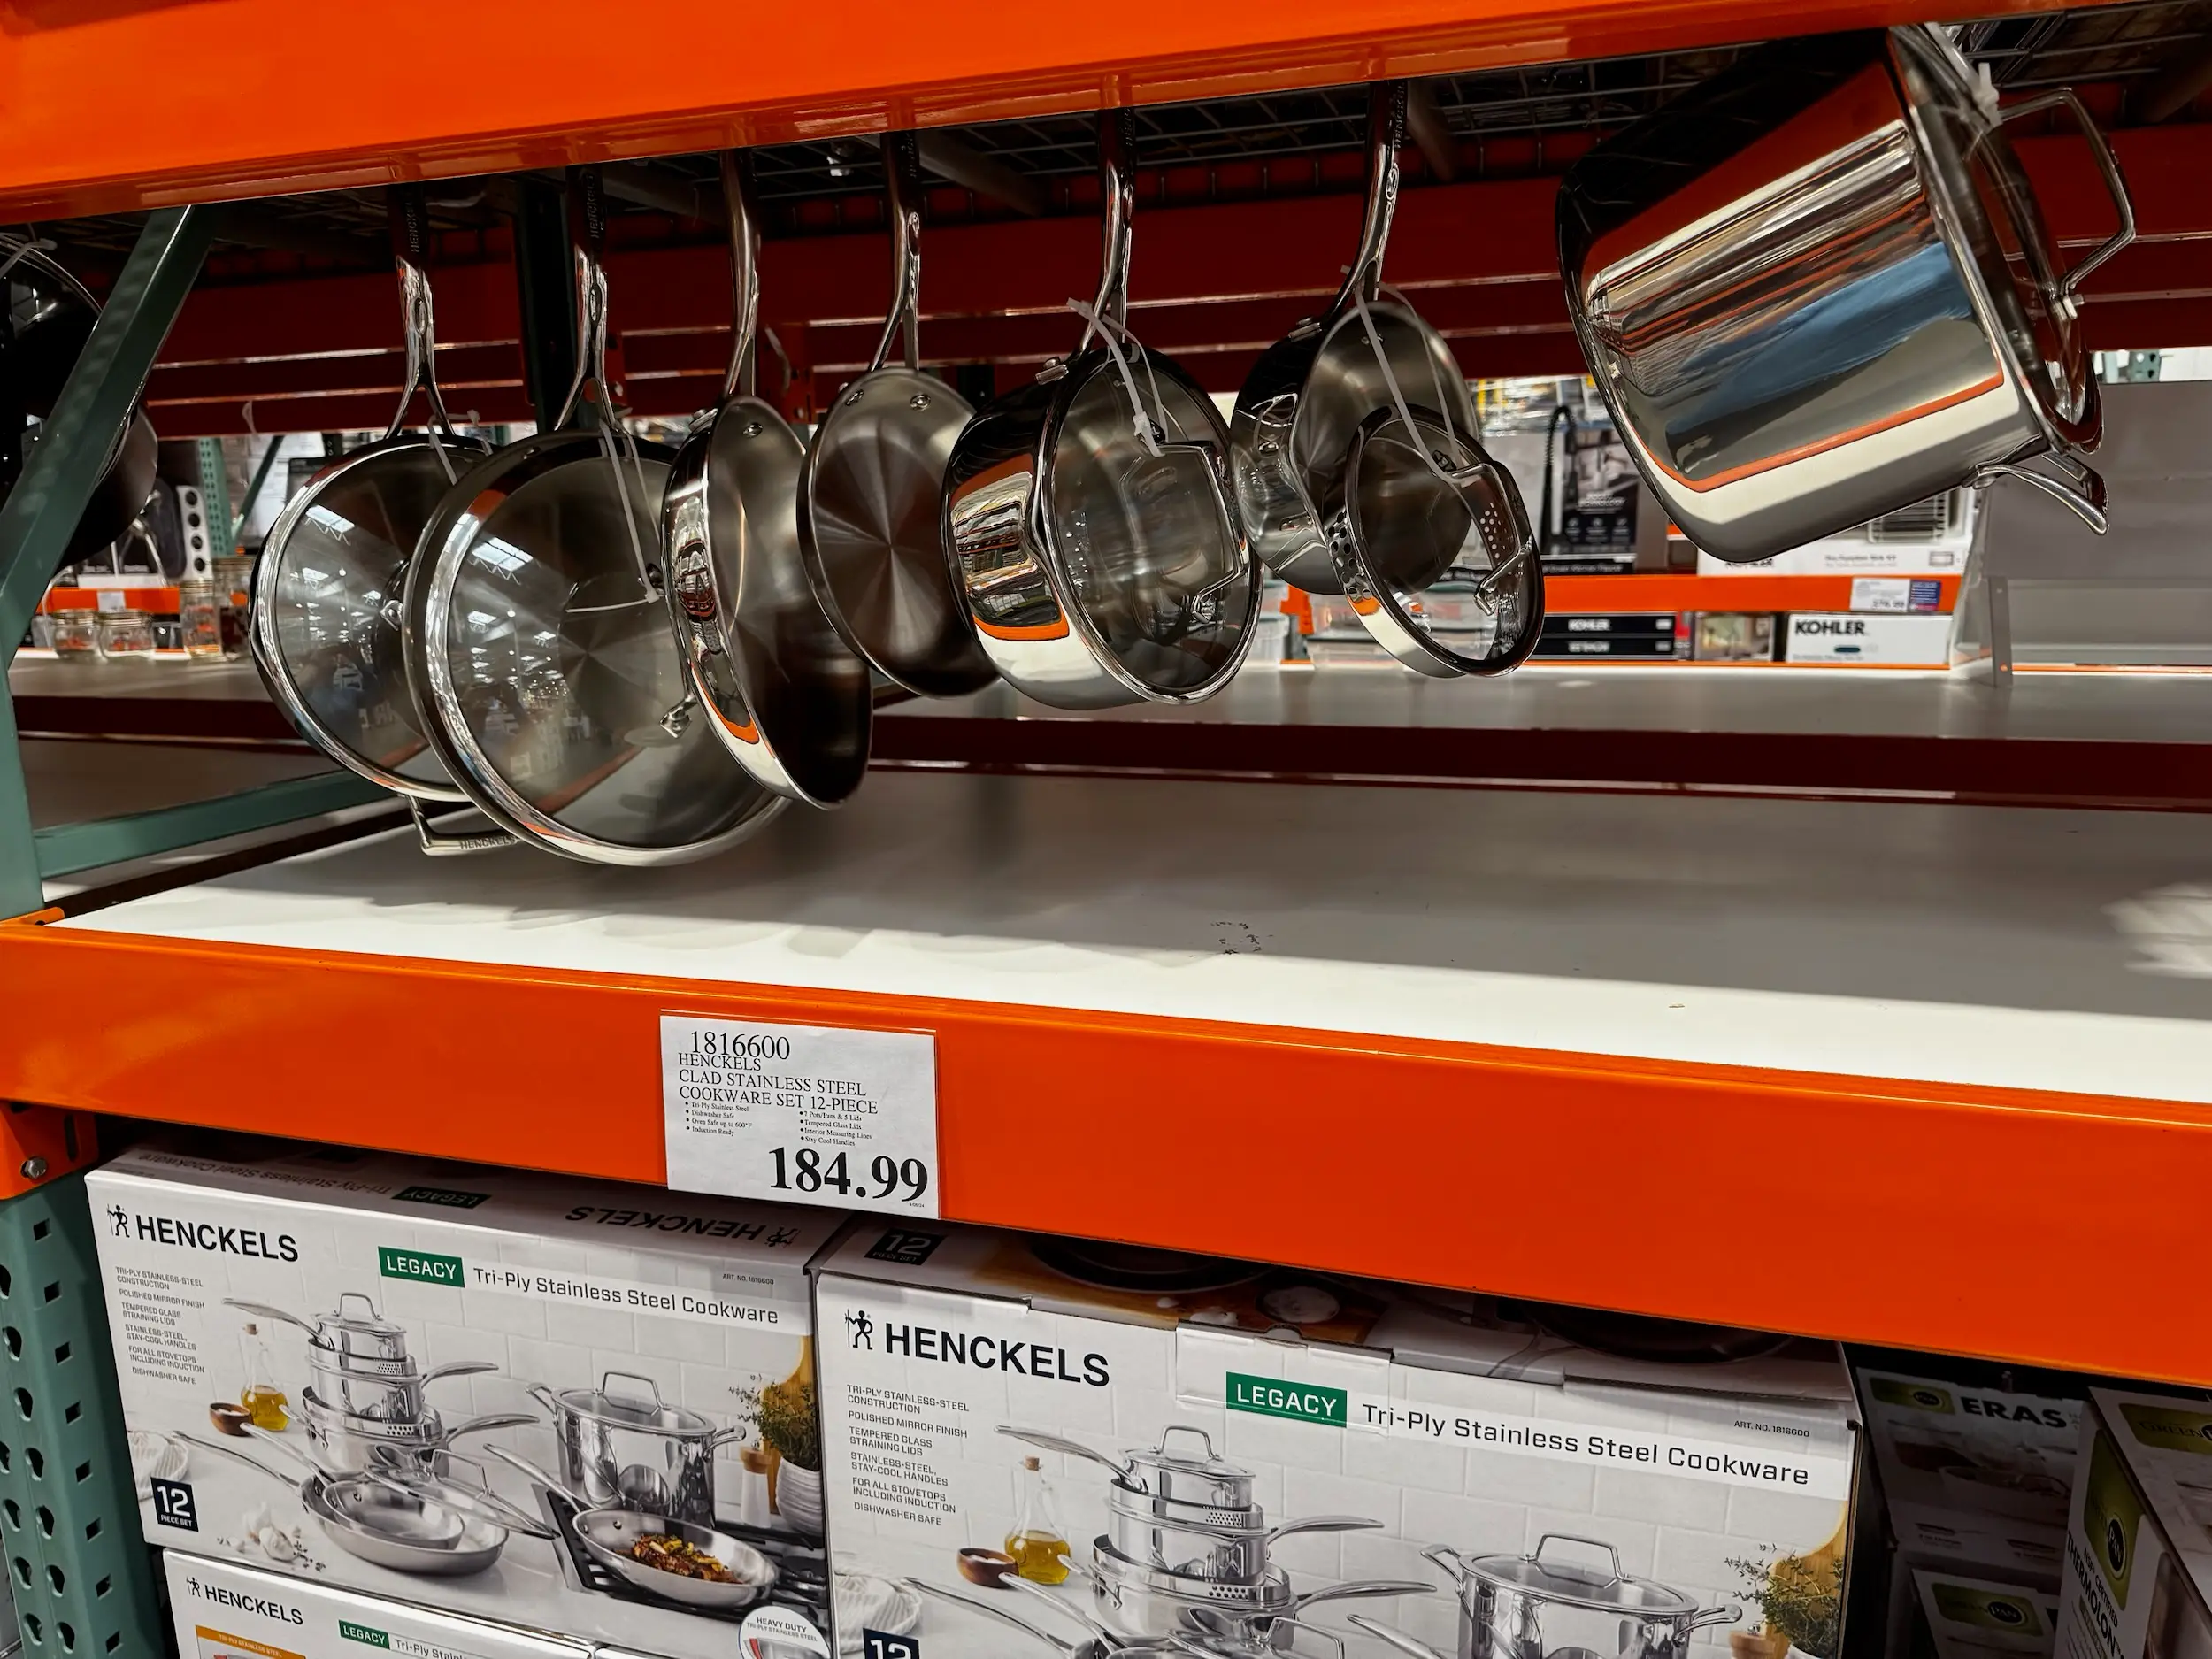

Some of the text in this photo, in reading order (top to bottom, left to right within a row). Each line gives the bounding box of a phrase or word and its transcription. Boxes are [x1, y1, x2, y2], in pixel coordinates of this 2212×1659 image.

[1795, 621, 1864, 635] KOHLER
[691, 1031, 790, 1059] 1816600
[678, 1052, 761, 1071] HENCKELS
[679, 1069, 866, 1096] CLAD STAINLESS STEEL
[680, 1085, 879, 1114] COOKWARE SET 12-PIECE
[718, 1128, 735, 1137] Ready
[804, 1118, 832, 1128] Tempered
[833, 1138, 856, 1147] Handles
[769, 1147, 928, 1202] 184.99
[565, 1207, 767, 1240] HENCKELS
[135, 1214, 299, 1262] HENCKELS
[885, 1233, 932, 1256] 12
[116, 1266, 204, 1287] TRI-PLY STAINLESS-STEEL
[387, 1256, 457, 1279] LEGACY
[117, 1276, 170, 1290] CONSTRUCTION
[119, 1288, 205, 1309] POLISHED MIRROR FINISH
[473, 1268, 779, 1324] Tri-Ply Stainless Steel Cookware
[121, 1302, 181, 1318] TEMPERED GLASS
[123, 1310, 176, 1325] STRAINING LIDS
[126, 1323, 188, 1341] STAINLESS-STEEL,
[127, 1332, 197, 1351] STAY-COOL HANDLES
[128, 1345, 142, 1354] FOR
[157, 1350, 197, 1363] STOVETOPS
[130, 1354, 205, 1373] INCLUDING INDUCTION
[886, 1323, 1110, 1386] HENCKELS
[132, 1366, 197, 1385] DISHWASHER SAFE
[847, 1384, 970, 1411] TRI-PLY STAINLESS-STEEL
[848, 1394, 921, 1414] CONSTRUCTION
[1237, 1383, 1337, 1416] LEGACY
[1961, 1396, 2067, 1428] ERAS
[849, 1410, 968, 1439] POLISHED MIRROR FINISH
[1734, 1420, 1810, 1437] ART. NO. 1816600
[849, 1426, 933, 1448] TEMPERED GLASS
[849, 1436, 923, 1456] STRAINING LIDS
[1363, 1403, 1809, 1486] Tri-Ply Stainless Steel Cookware
[851, 1451, 937, 1476] STAINLESS-STEEL,
[852, 1462, 949, 1486] STAY-COOL HANDLES
[852, 1477, 946, 1502] FOR ALL STOVETOPS
[853, 1486, 956, 1514] INCLUDING INDUCTION
[157, 1486, 191, 1517] 12
[160, 1514, 193, 1527] PIECE SET
[854, 1502, 942, 1526] DISHWASHER SAFE
[204, 1584, 303, 1625] HENCKELS
[2094, 1574, 2118, 1629] CERTIFIED
[342, 1624, 385, 1645] LEGACY
[757, 1617, 807, 1633] HEAVY DUTY
[769, 1626, 799, 1638] STAINLESS
[801, 1632, 818, 1641] STEEL
[395, 1639, 429, 1657] Tri-Ply
[871, 1639, 912, 1659] 12
